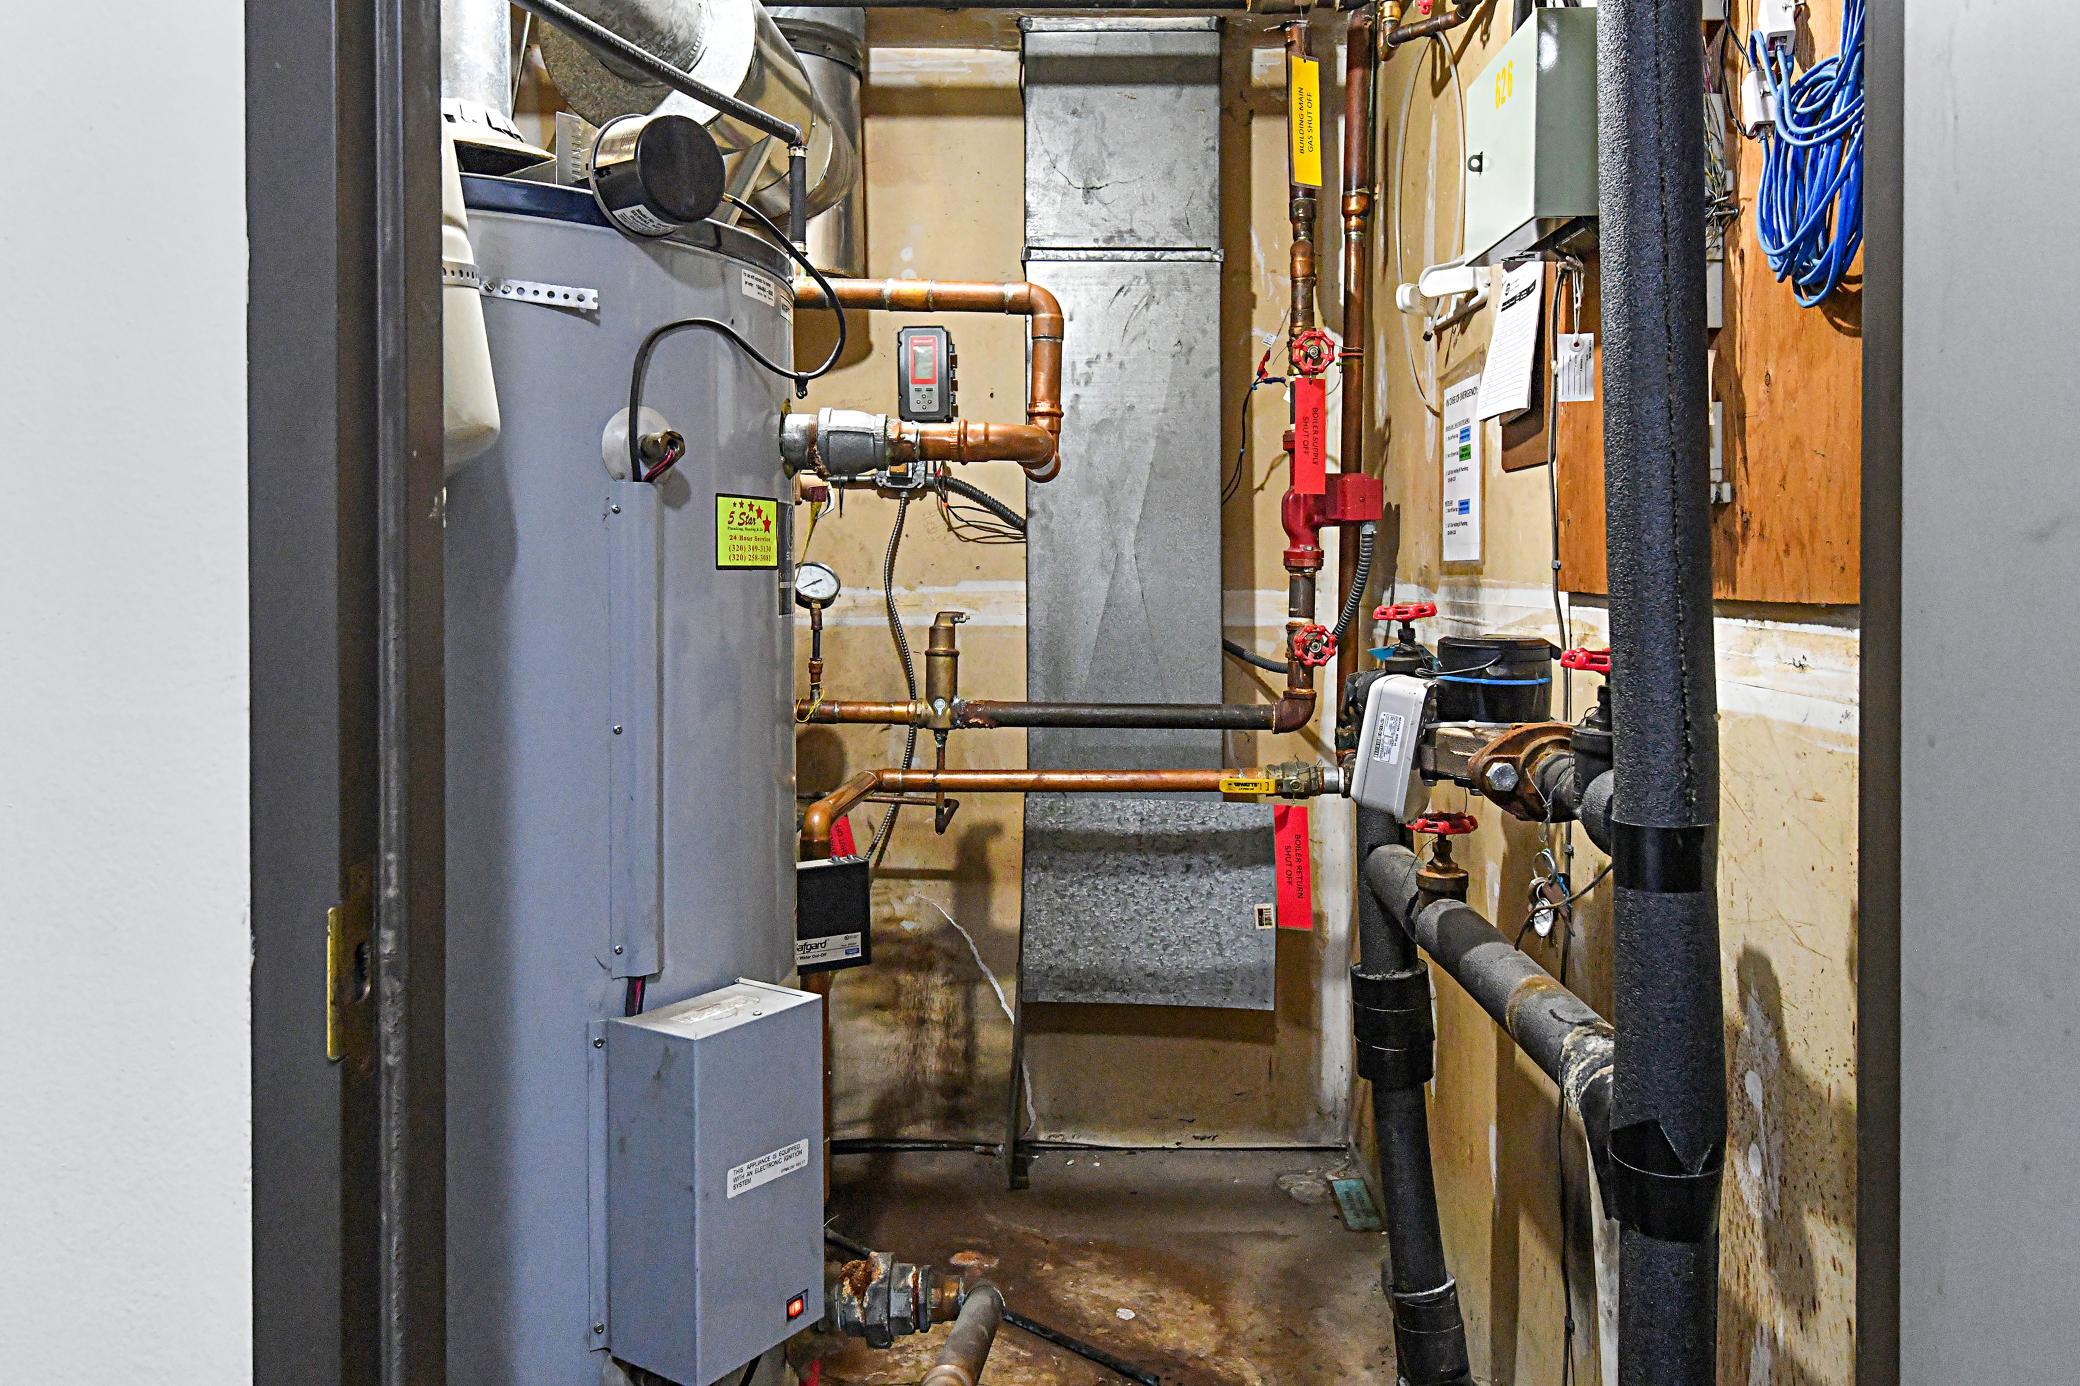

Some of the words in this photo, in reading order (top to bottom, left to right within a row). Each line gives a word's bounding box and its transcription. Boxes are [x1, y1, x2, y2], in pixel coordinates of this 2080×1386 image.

[1495, 59, 1513, 110] 626
[728, 510, 735, 525] 5
[738, 511, 756, 526] Star
[728, 544, 746, 553] (320)
[728, 553, 746, 562] (320)
[1296, 863, 1304, 899] RETURN
[796, 939, 827, 954] afgard
[733, 1167, 744, 1175] THIS
[747, 1155, 770, 1170] APPLIANCE
[778, 1144, 800, 1157] EQUIPPED
[733, 1174, 745, 1183] WITH
[754, 1158, 782, 1174] ELECTRONIC
[784, 1149, 803, 1162] IGNITION
[733, 1178, 752, 1190] SYSTEM
